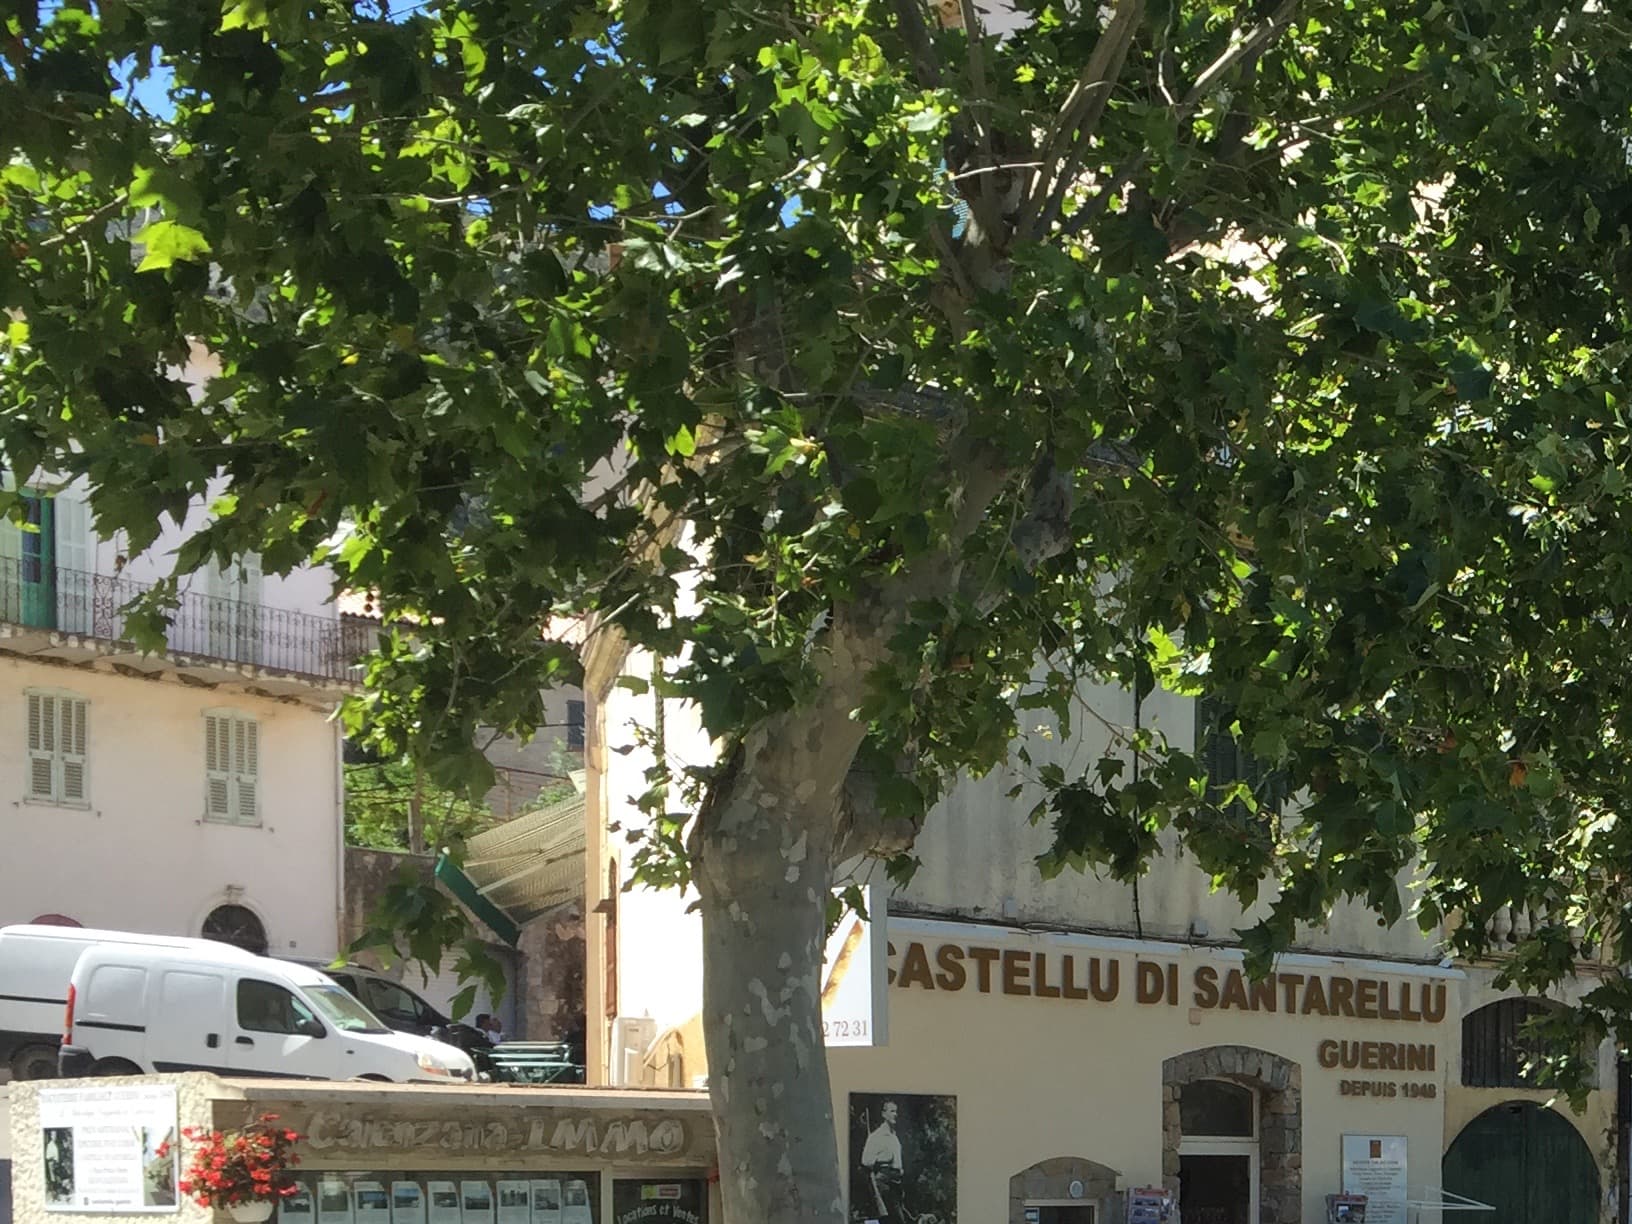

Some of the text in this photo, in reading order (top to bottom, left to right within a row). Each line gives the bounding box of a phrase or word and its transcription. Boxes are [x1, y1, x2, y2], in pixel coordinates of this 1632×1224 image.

[888, 940, 1447, 1024] ASTELLU DI SANTARELLU
[833, 1021, 849, 1037] 72
[853, 1020, 867, 1036] 31
[1317, 1040, 1436, 1072] GUERINI
[1340, 1080, 1396, 1097] DEPUIS
